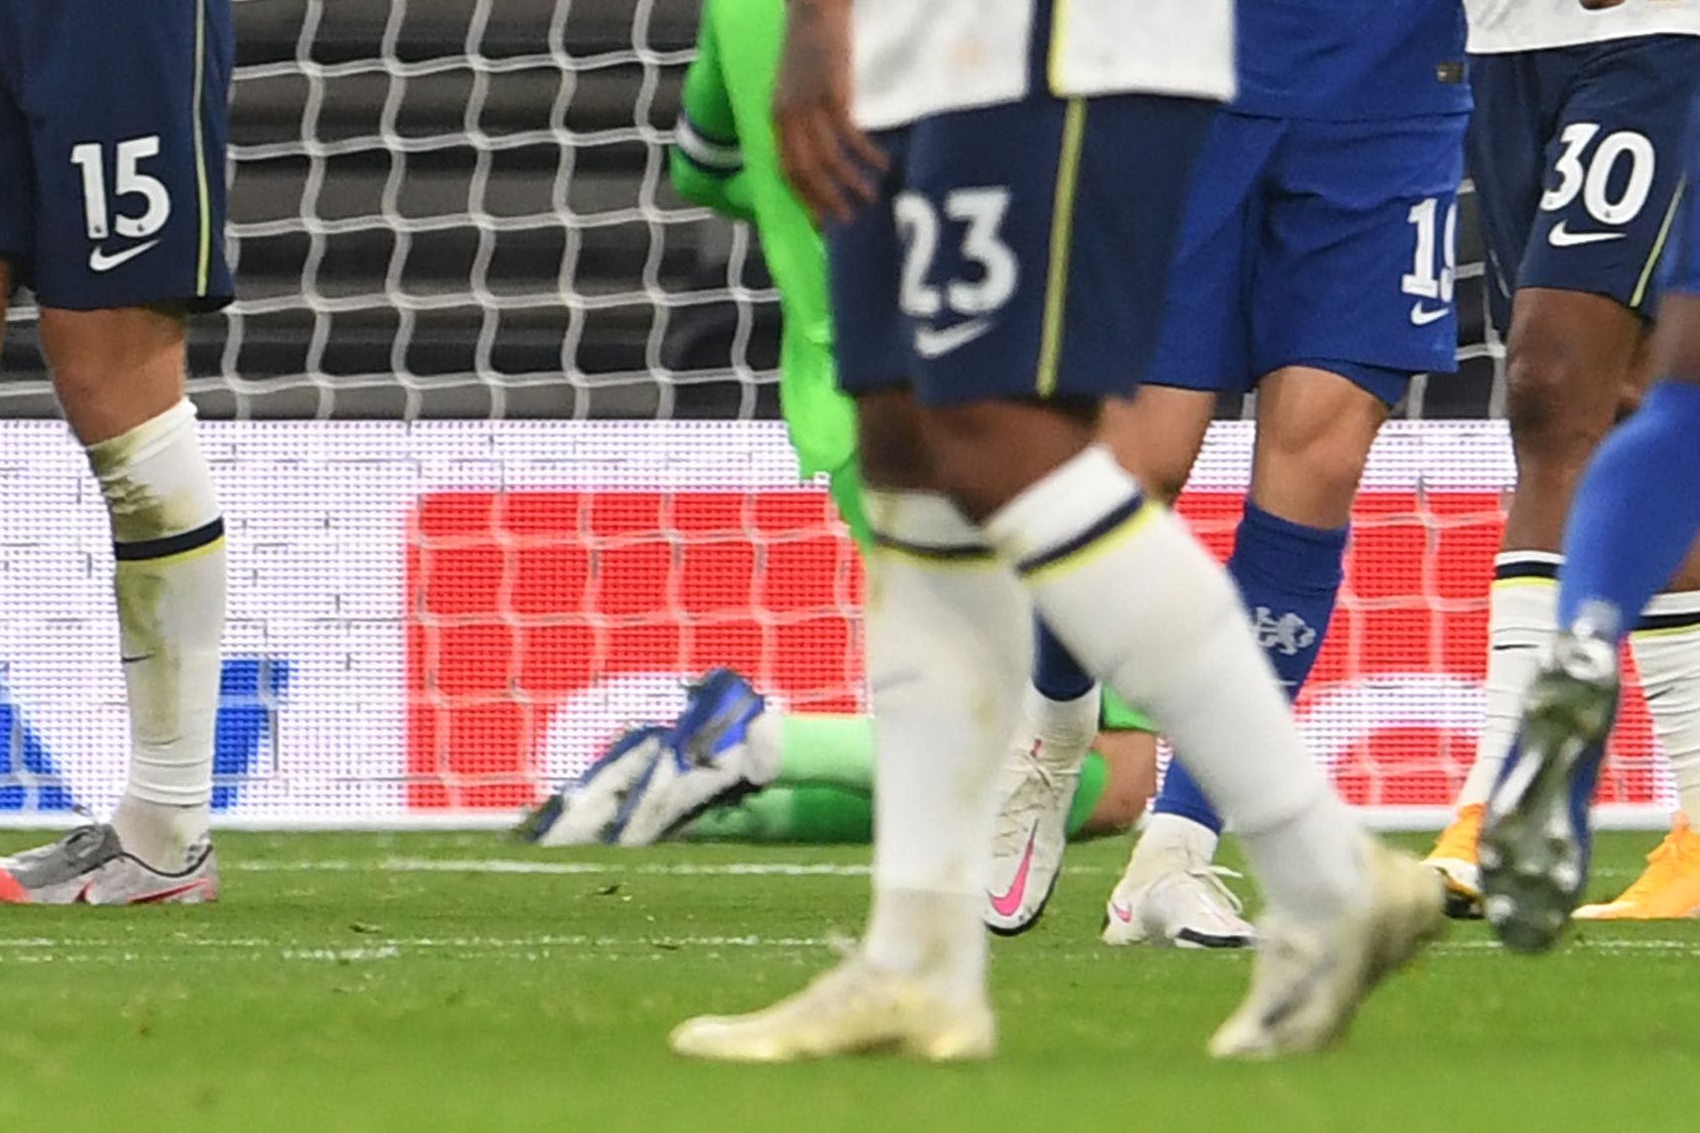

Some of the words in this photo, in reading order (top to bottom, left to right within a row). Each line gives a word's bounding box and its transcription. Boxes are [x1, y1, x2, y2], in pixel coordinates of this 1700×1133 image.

[70, 135, 172, 239] 15
[1540, 122, 1656, 225] 30
[894, 187, 1018, 315] 23
